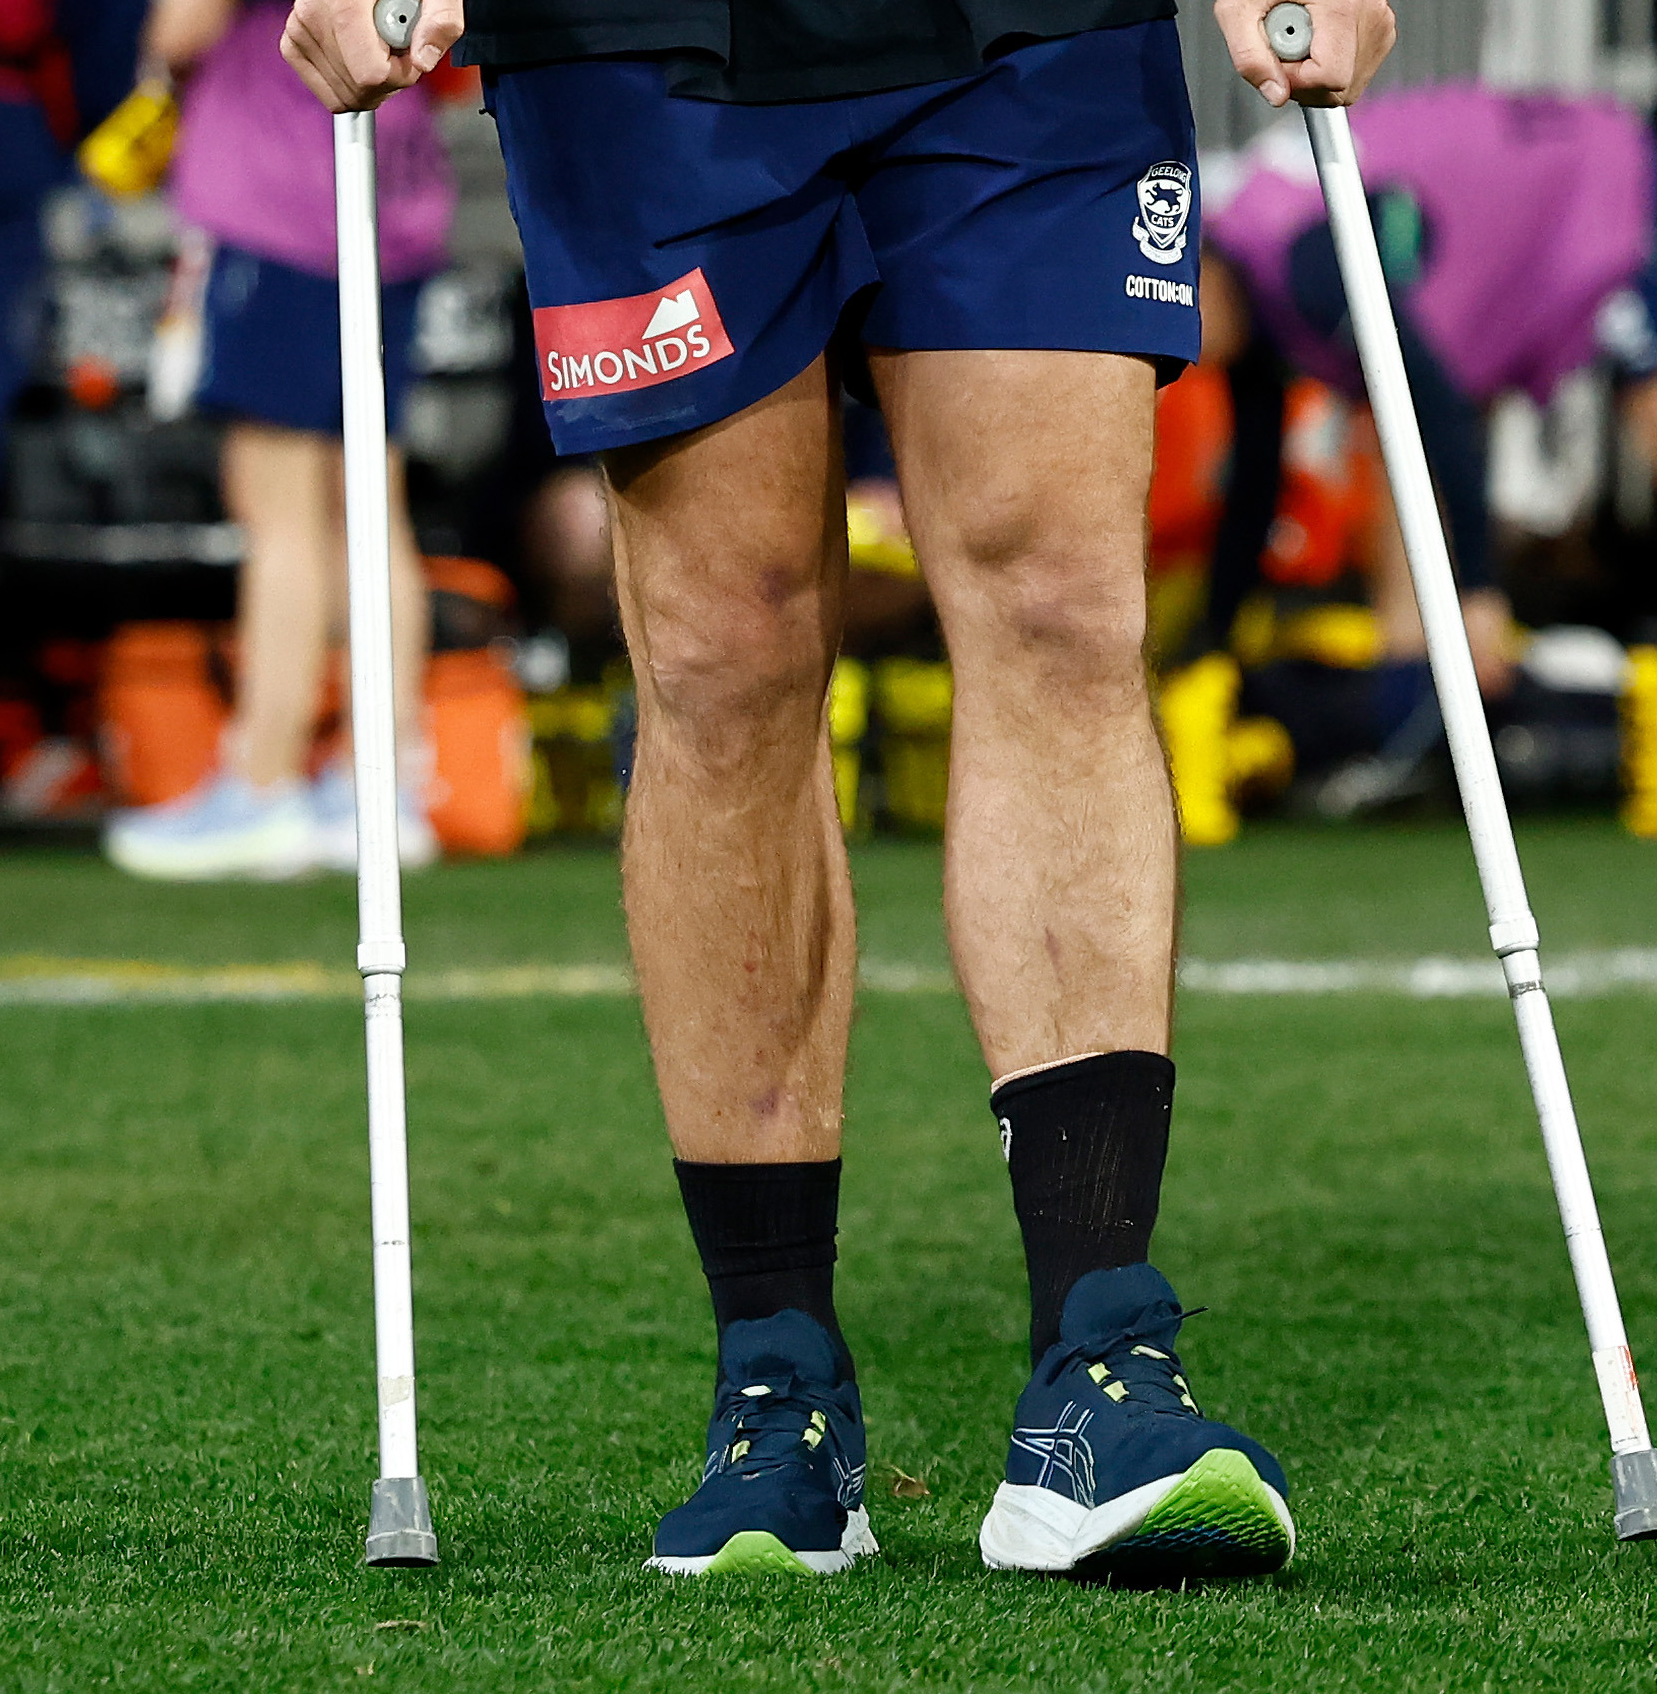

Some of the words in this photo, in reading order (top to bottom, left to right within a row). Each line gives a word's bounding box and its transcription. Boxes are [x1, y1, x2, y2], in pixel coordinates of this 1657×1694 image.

[1151, 166, 1187, 183] GEELONG
[1150, 213, 1175, 228] CATS
[1125, 274, 1194, 307] COTTON:ON
[547, 324, 711, 392] SIMONDS
